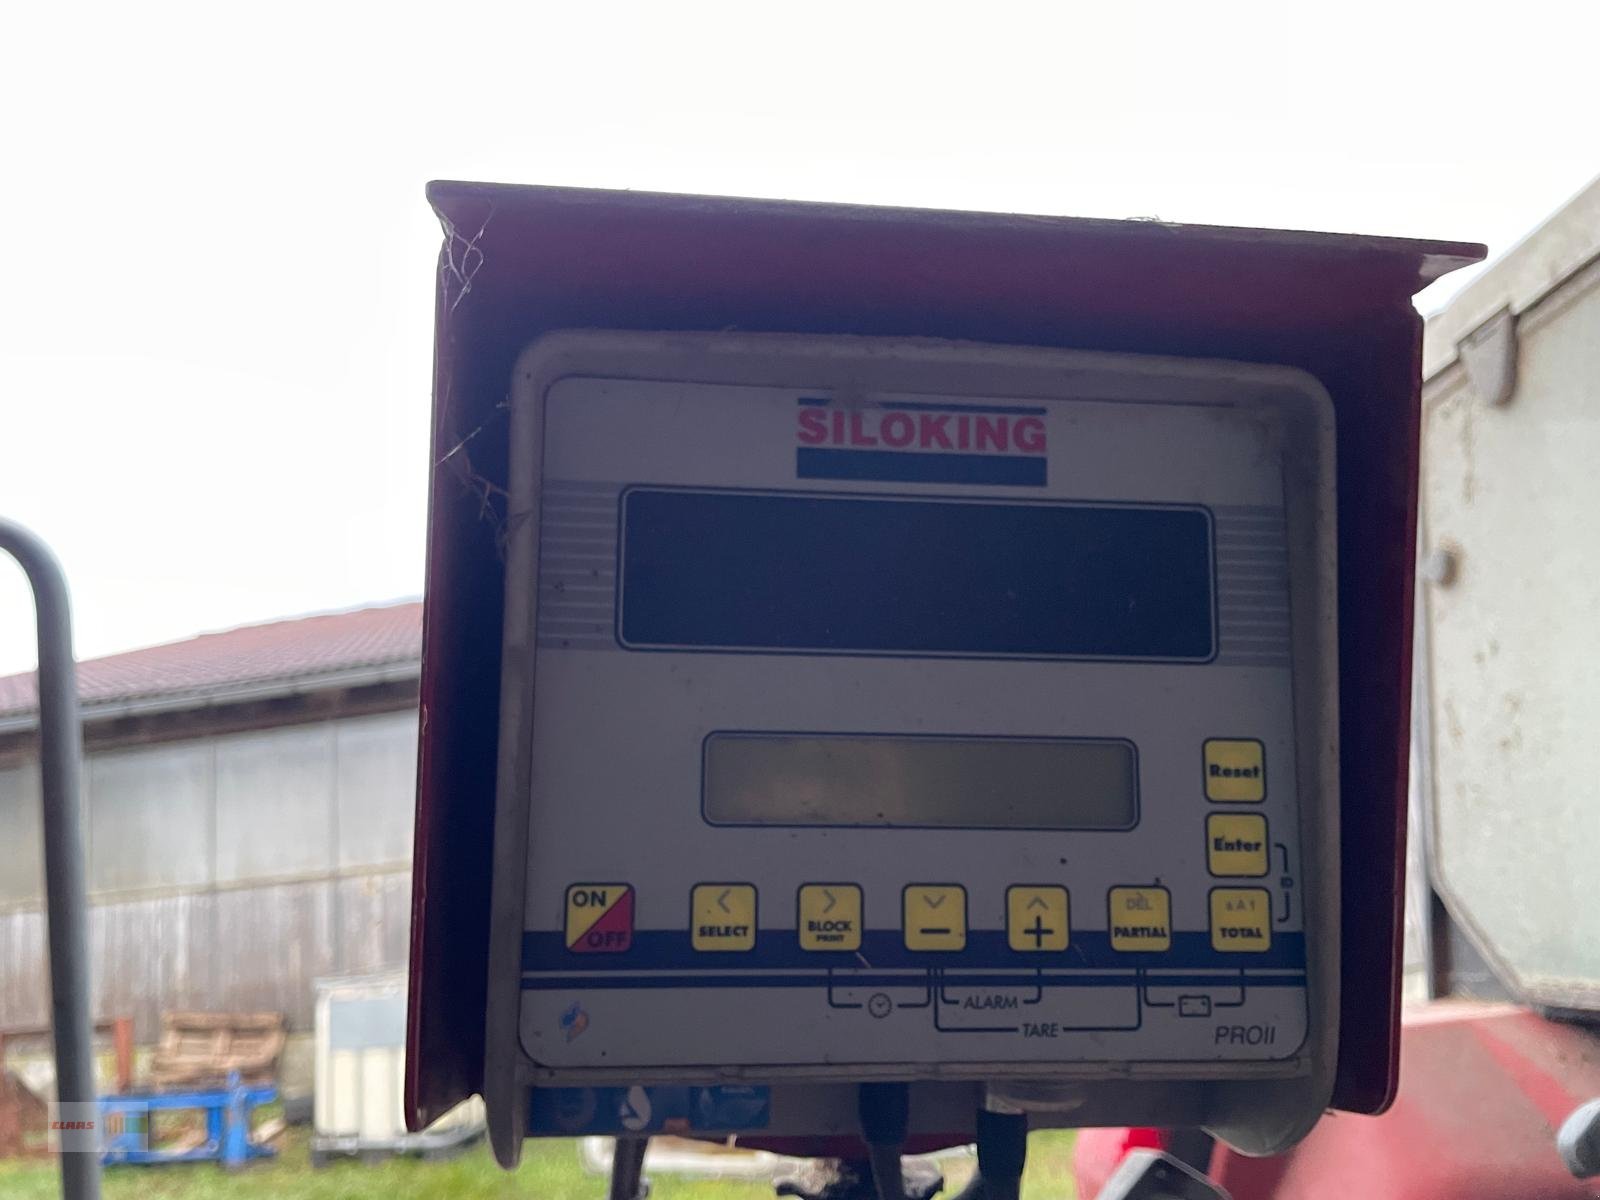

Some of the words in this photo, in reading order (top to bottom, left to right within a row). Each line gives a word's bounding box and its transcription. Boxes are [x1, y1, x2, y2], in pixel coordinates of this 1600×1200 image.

[796, 408, 1046, 453] SILOKING
[1209, 764, 1260, 778] Reset
[1213, 837, 1262, 852] Enter
[572, 890, 607, 907] ON
[699, 924, 749, 938] SELECT
[808, 920, 852, 932] BLOCK
[1114, 926, 1167, 939] PARTIAL
[1220, 927, 1263, 939] TOTAL
[587, 931, 625, 948] OFF
[964, 996, 1018, 1010] ALARM
[1023, 1022, 1059, 1038] TARE
[1214, 1025, 1275, 1046] PROII
